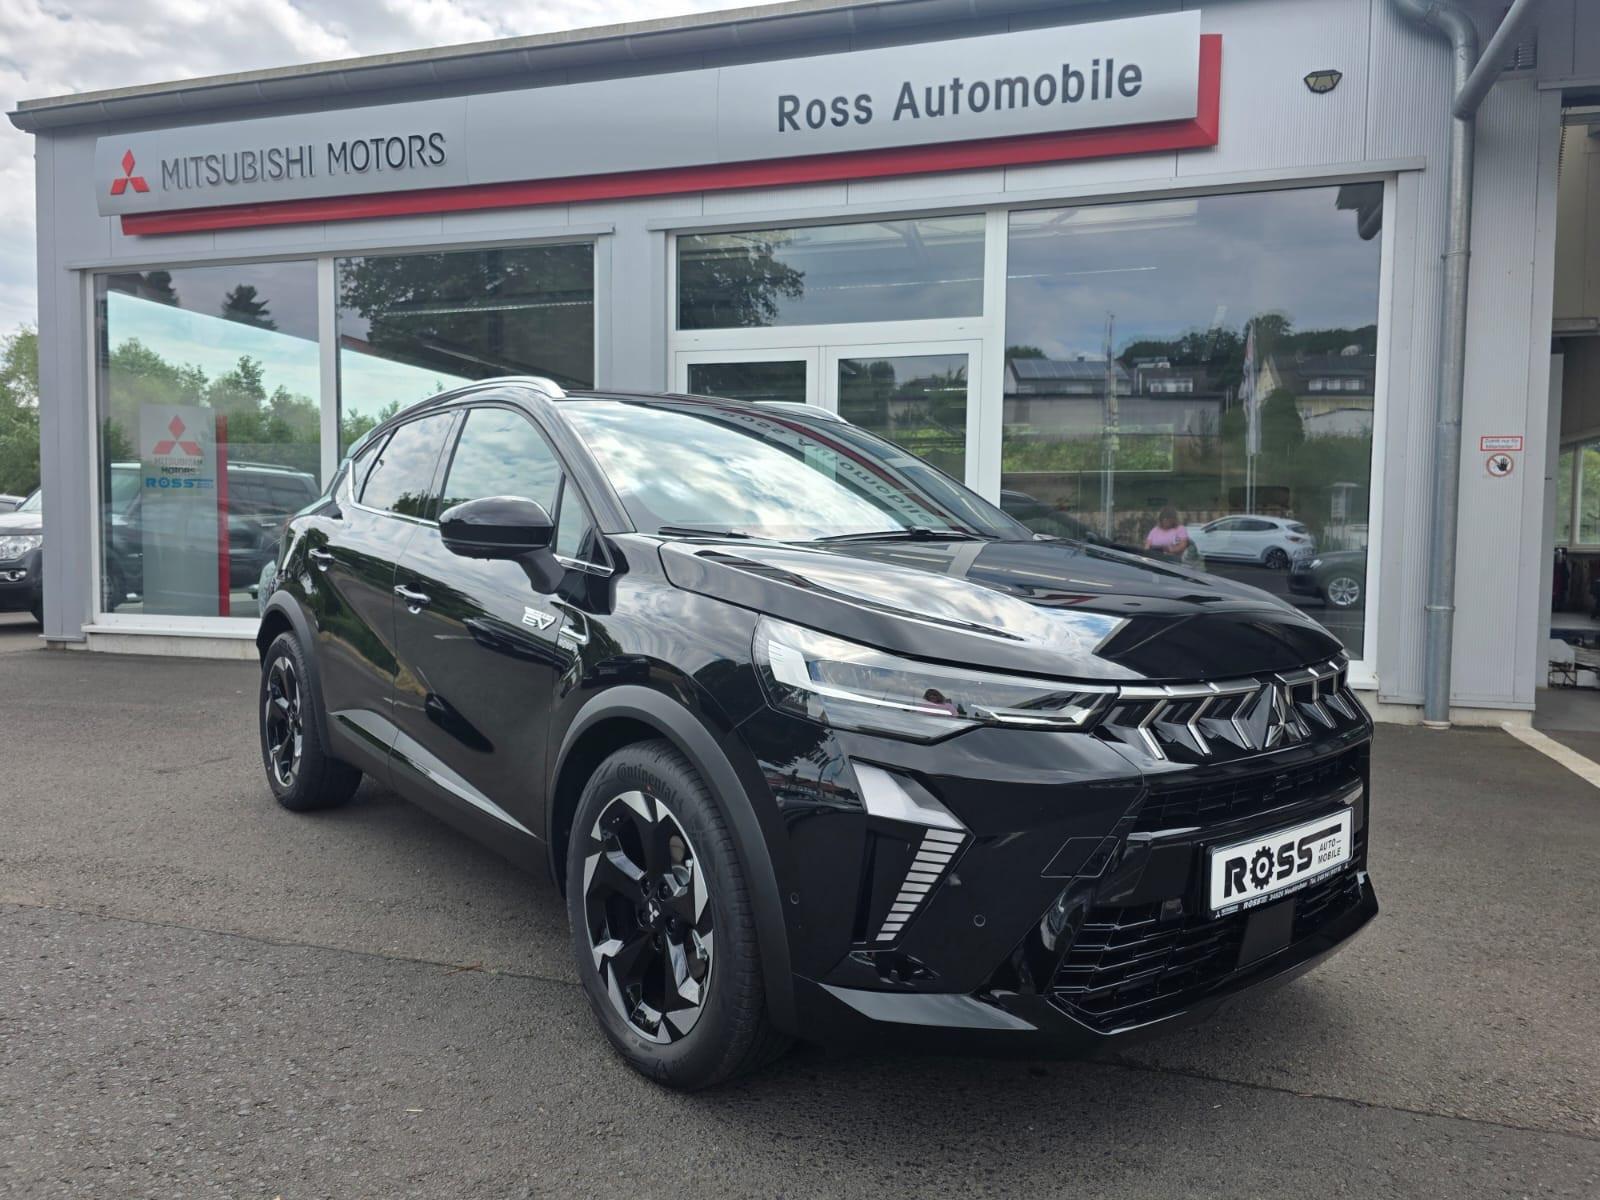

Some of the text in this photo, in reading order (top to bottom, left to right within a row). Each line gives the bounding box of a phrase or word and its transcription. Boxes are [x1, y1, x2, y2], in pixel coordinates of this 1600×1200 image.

[777, 58, 1142, 132] Ross Automobile
[161, 132, 446, 191] MITSUBISHI MOTORS
[145, 477, 213, 488] ROSS
[616, 762, 679, 800] Continental
[1224, 823, 1342, 899] ROSS
[1318, 847, 1341, 865] MOBILE
